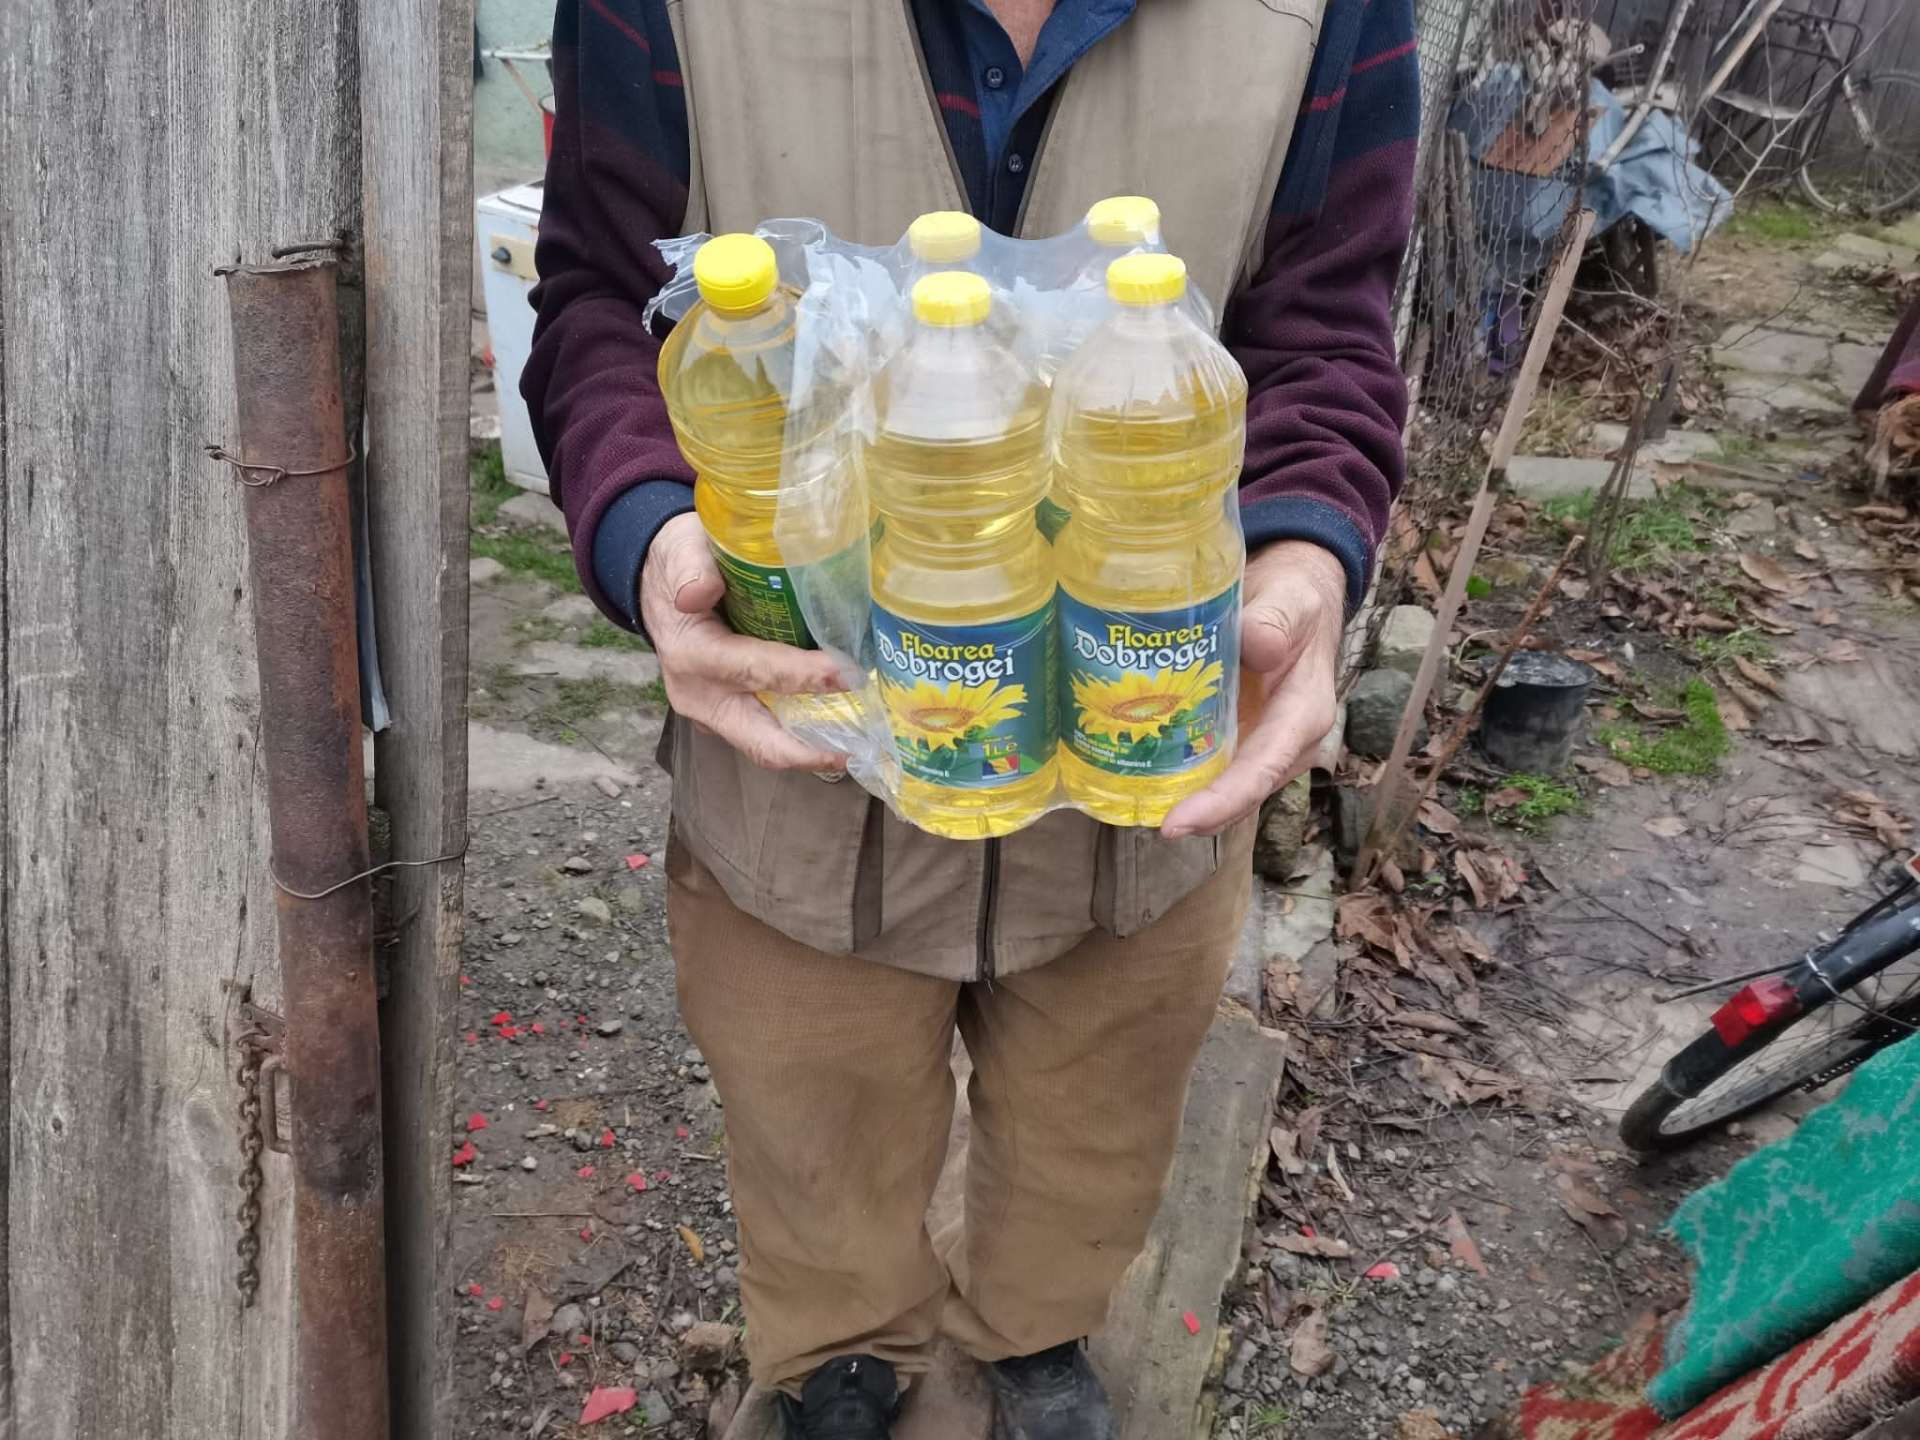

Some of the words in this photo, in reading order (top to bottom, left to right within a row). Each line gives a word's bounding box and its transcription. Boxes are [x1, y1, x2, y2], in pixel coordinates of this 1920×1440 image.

[899, 631, 995, 661] Floarea
[1074, 625, 1217, 671] Dobrogei
[1106, 624, 1204, 648] Floarea
[877, 629, 1015, 686] Dobrogei
